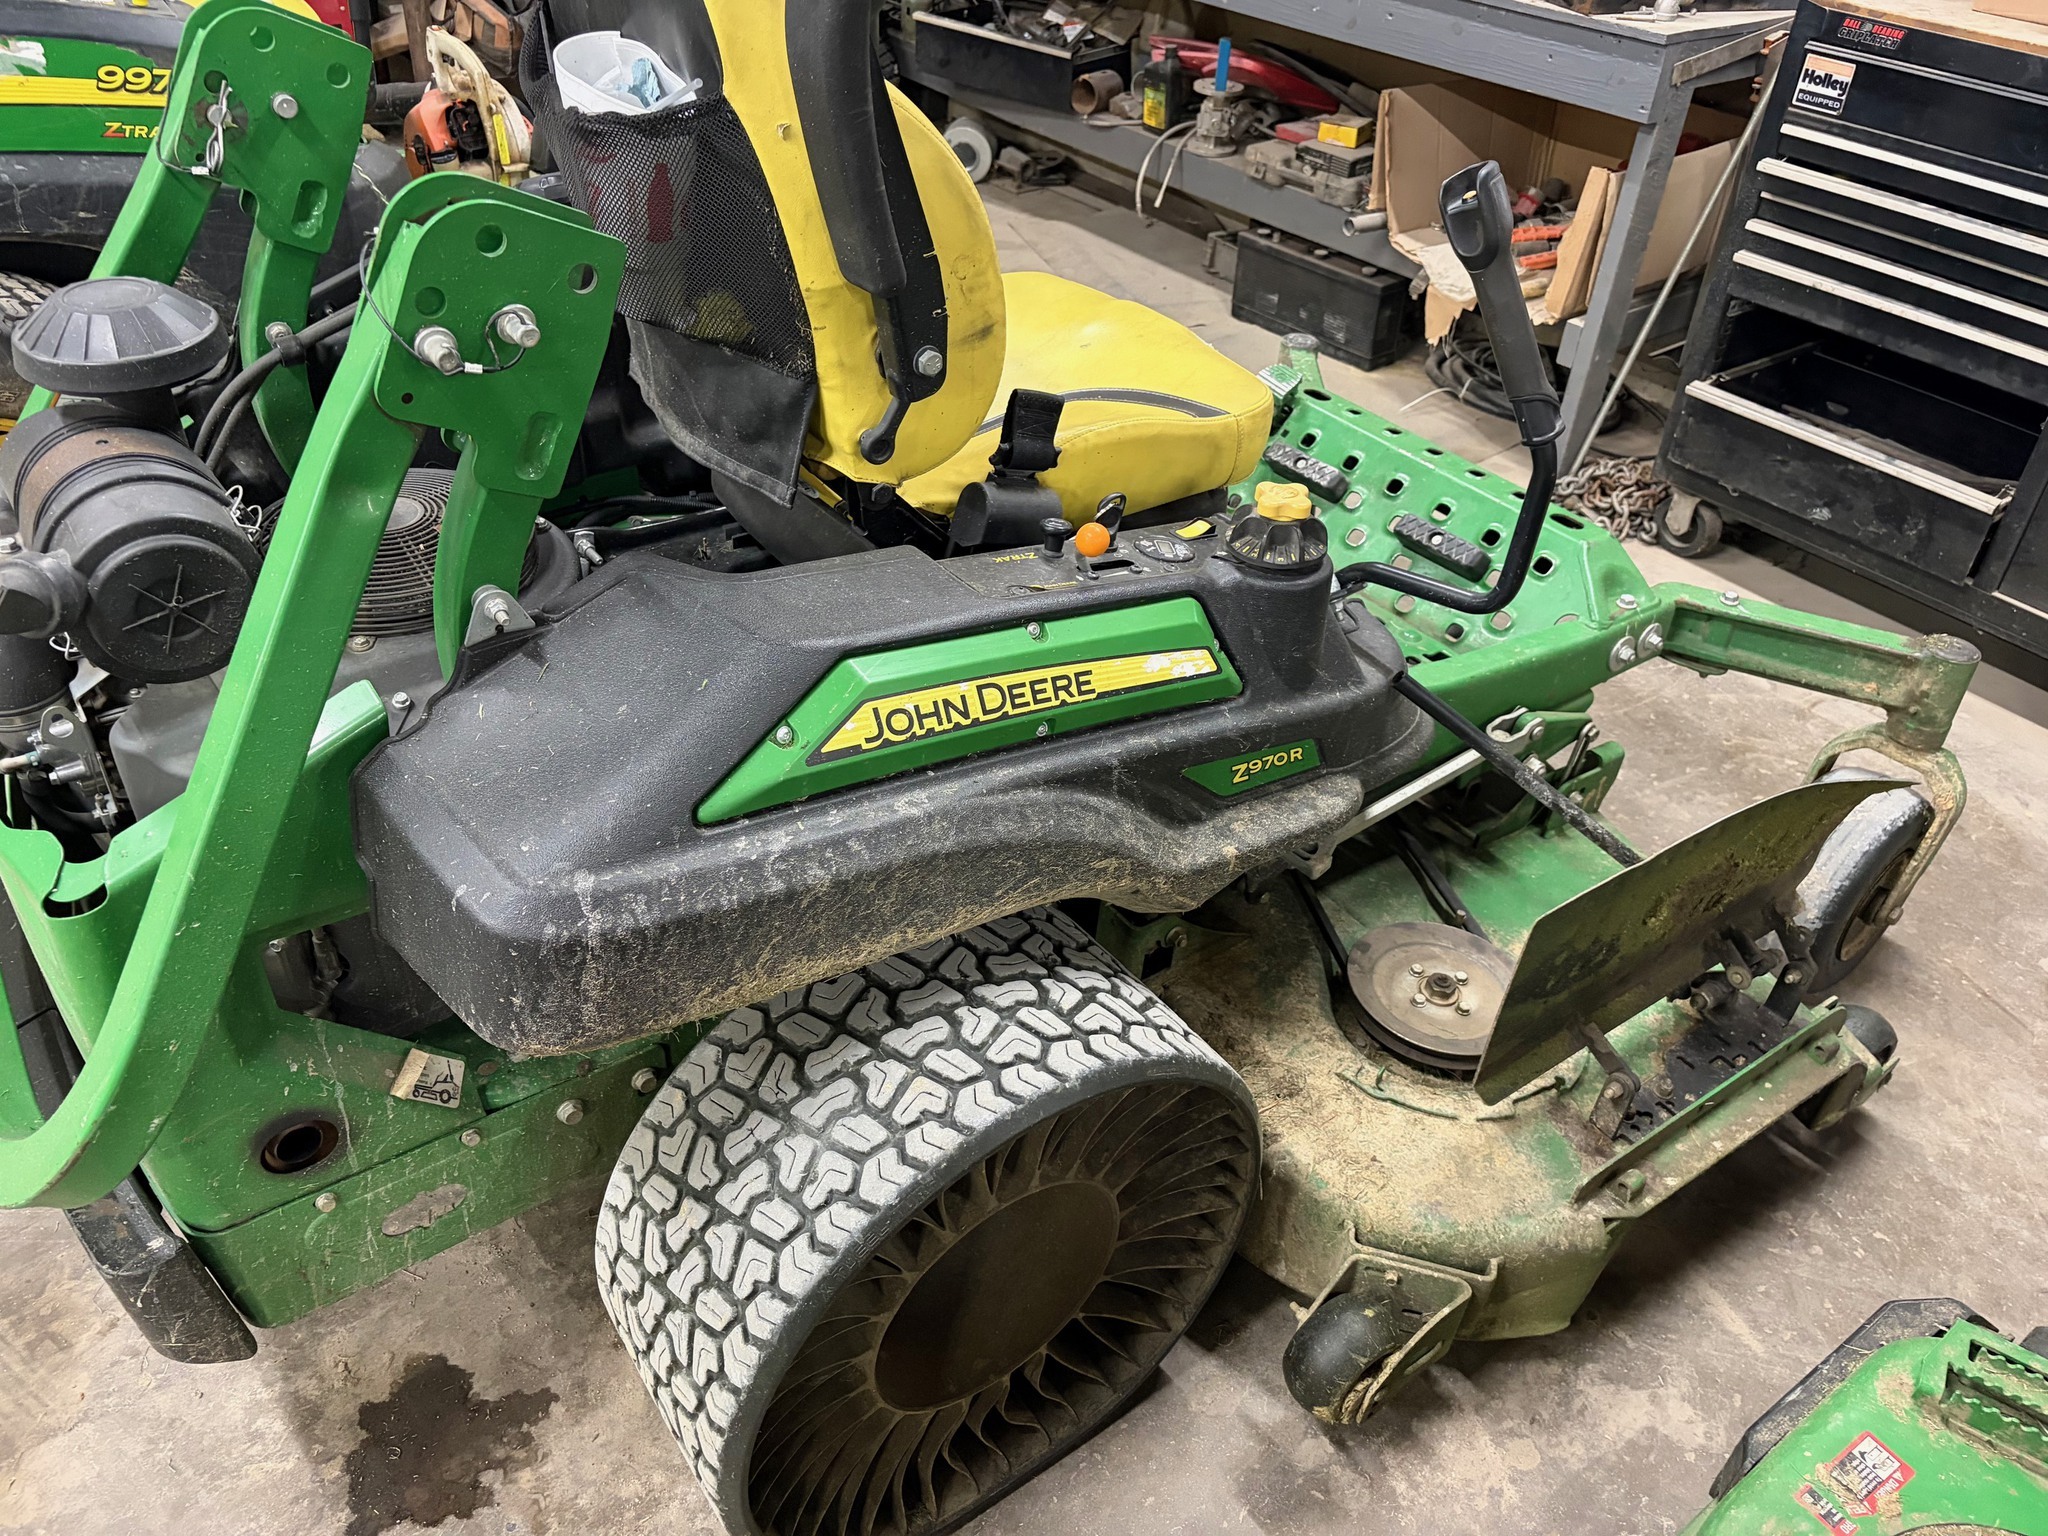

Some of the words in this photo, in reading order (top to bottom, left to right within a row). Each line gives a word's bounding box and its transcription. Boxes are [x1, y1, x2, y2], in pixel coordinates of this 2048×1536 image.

[1838, 27, 1901, 50] GRIPLATCH
[1843, 18, 1861, 29] BALL
[1872, 25, 1905, 40] BEARING
[97, 64, 171, 94] 997
[1802, 68, 1849, 97] Holley
[1798, 92, 1840, 109] EQUIPPED
[865, 694, 971, 743] JOHN
[976, 669, 1096, 716] DEERE
[1231, 746, 1303, 784] Z970R
